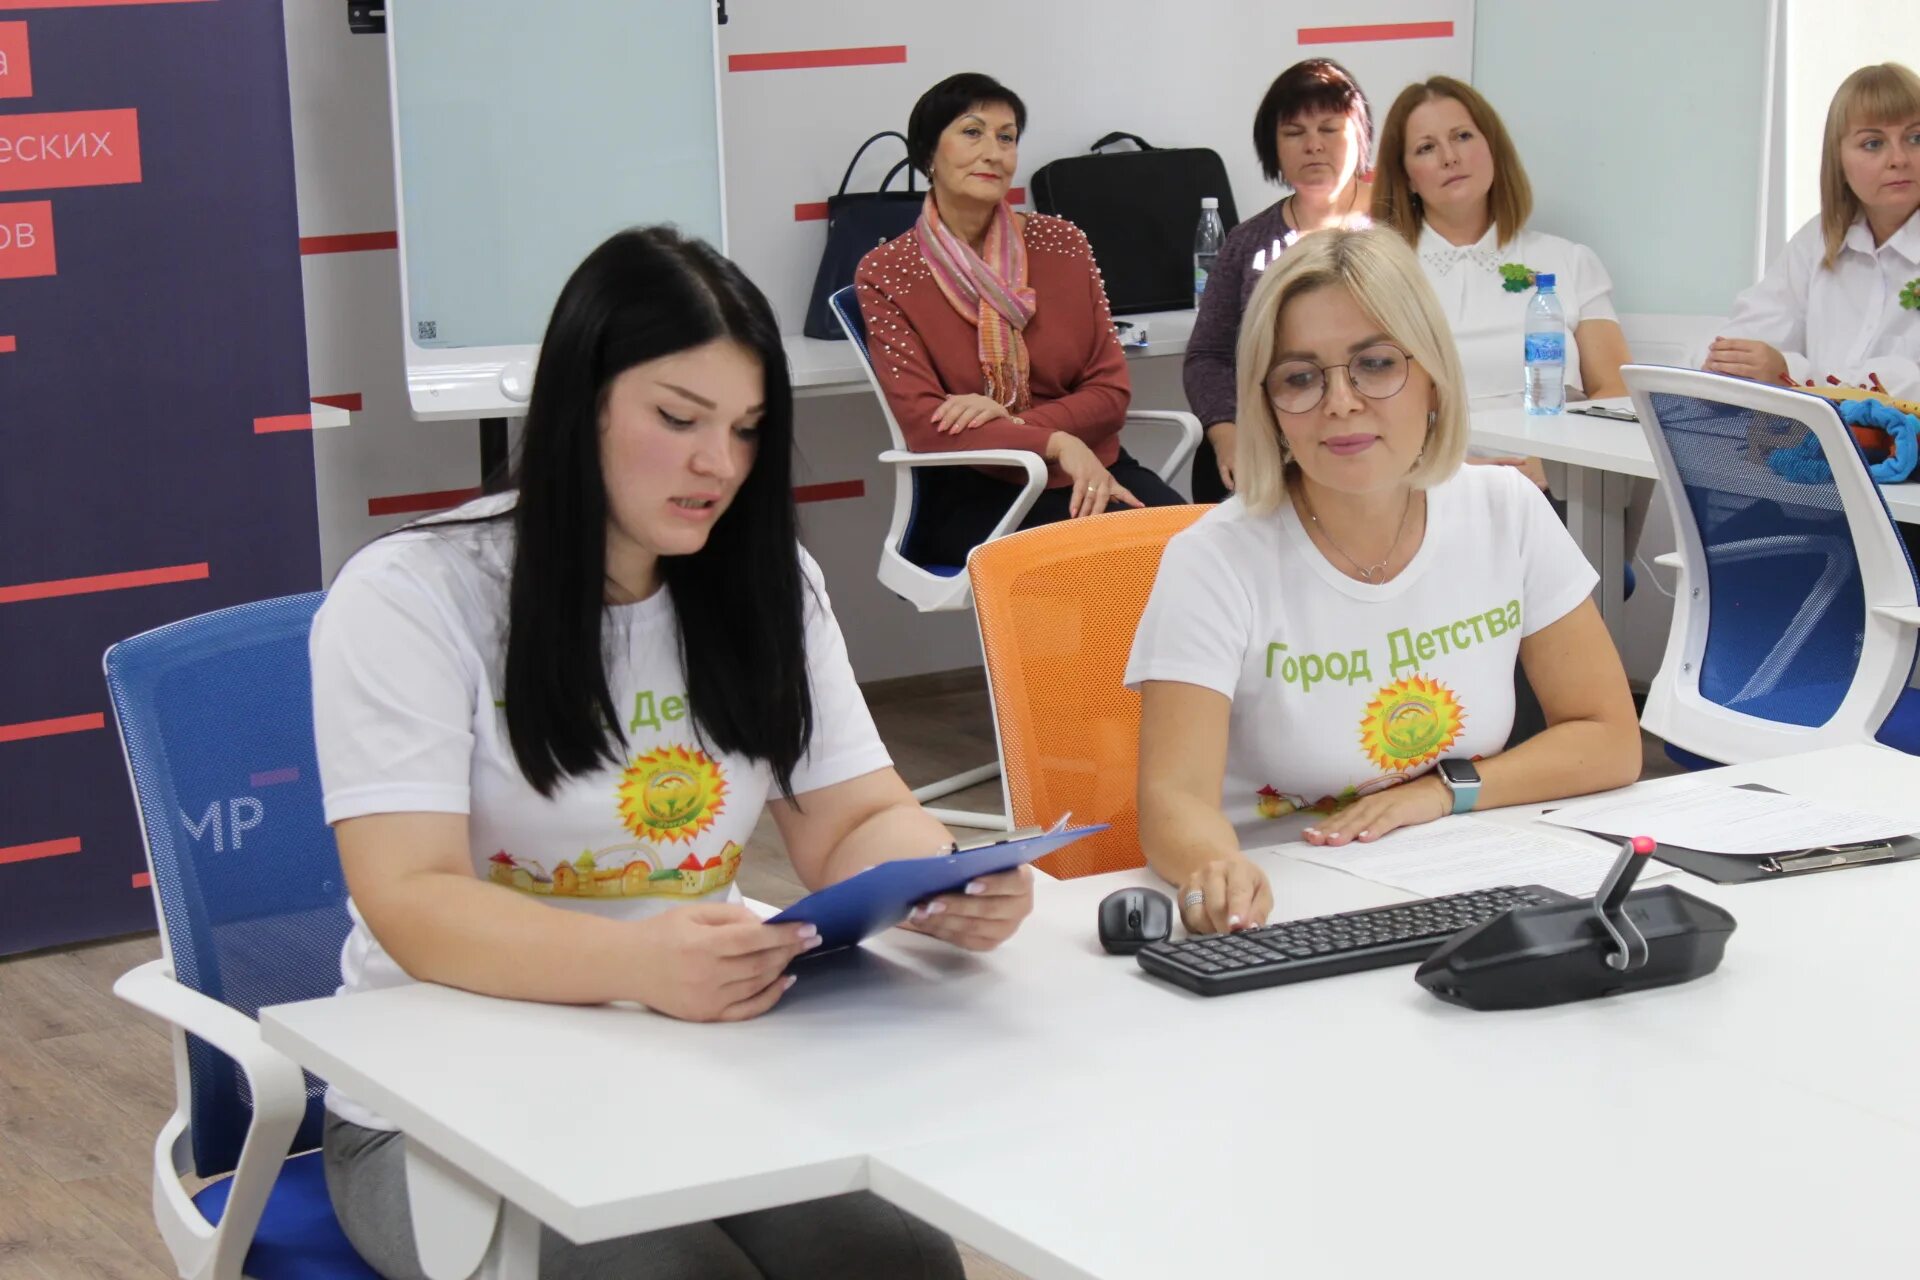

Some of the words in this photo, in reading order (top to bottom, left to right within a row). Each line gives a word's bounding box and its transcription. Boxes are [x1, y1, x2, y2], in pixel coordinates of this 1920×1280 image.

[0, 131, 112, 163] еских
[1265, 642, 1373, 693] Город
[1387, 599, 1522, 677] Детства
[630, 690, 688, 735] Де
